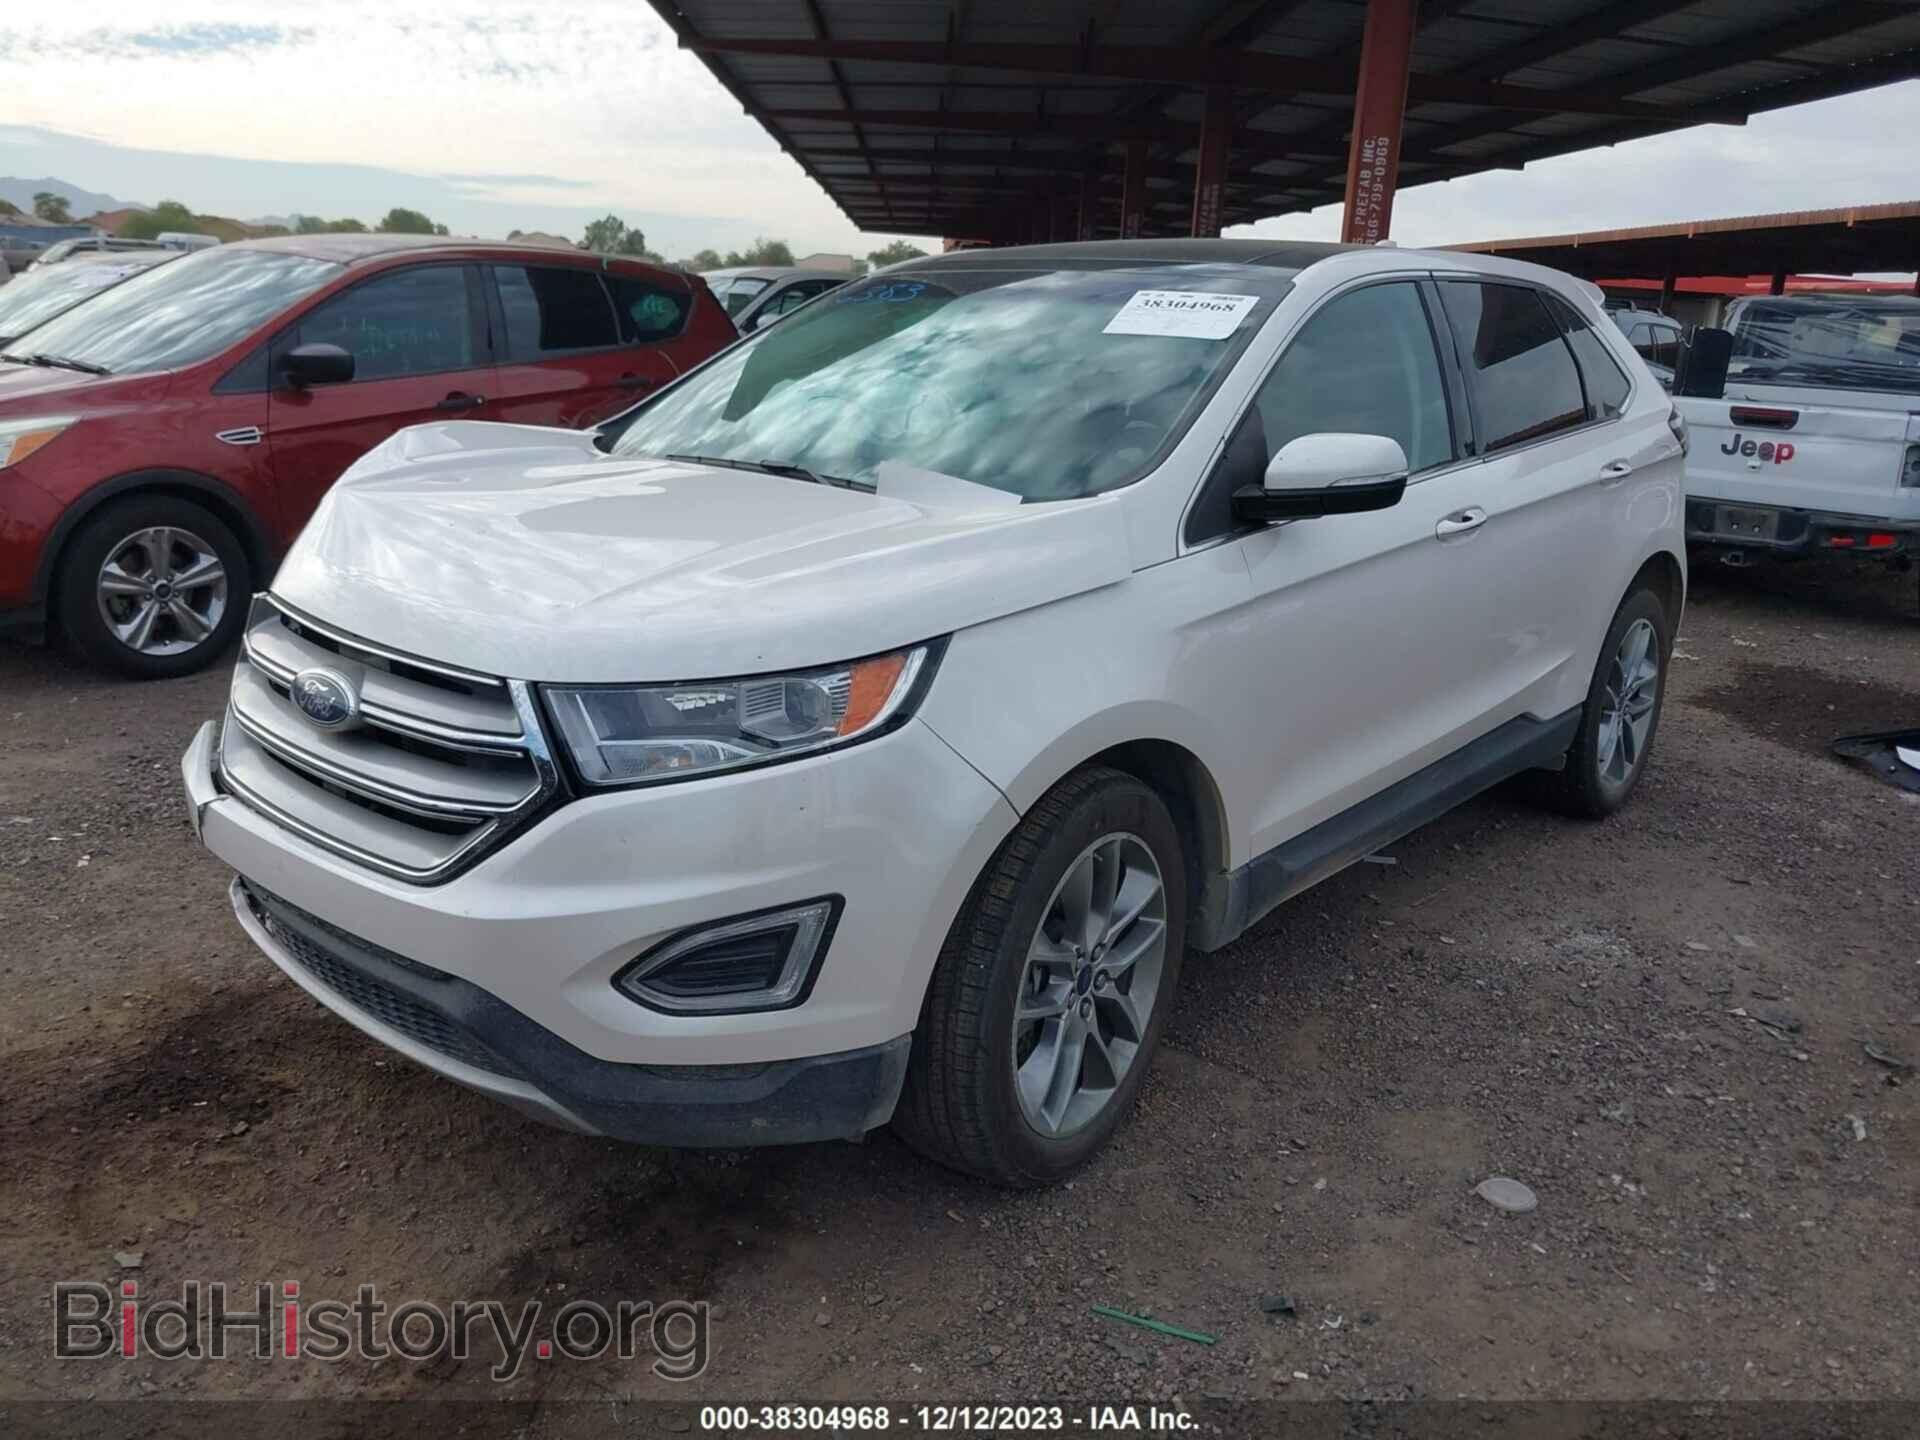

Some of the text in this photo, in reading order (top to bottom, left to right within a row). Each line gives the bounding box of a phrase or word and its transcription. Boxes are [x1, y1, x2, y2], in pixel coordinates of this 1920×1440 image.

[1354, 170, 1372, 225] PREFAB
[1144, 299, 1236, 312] 38304968
[1721, 434, 1795, 464] Jeep
